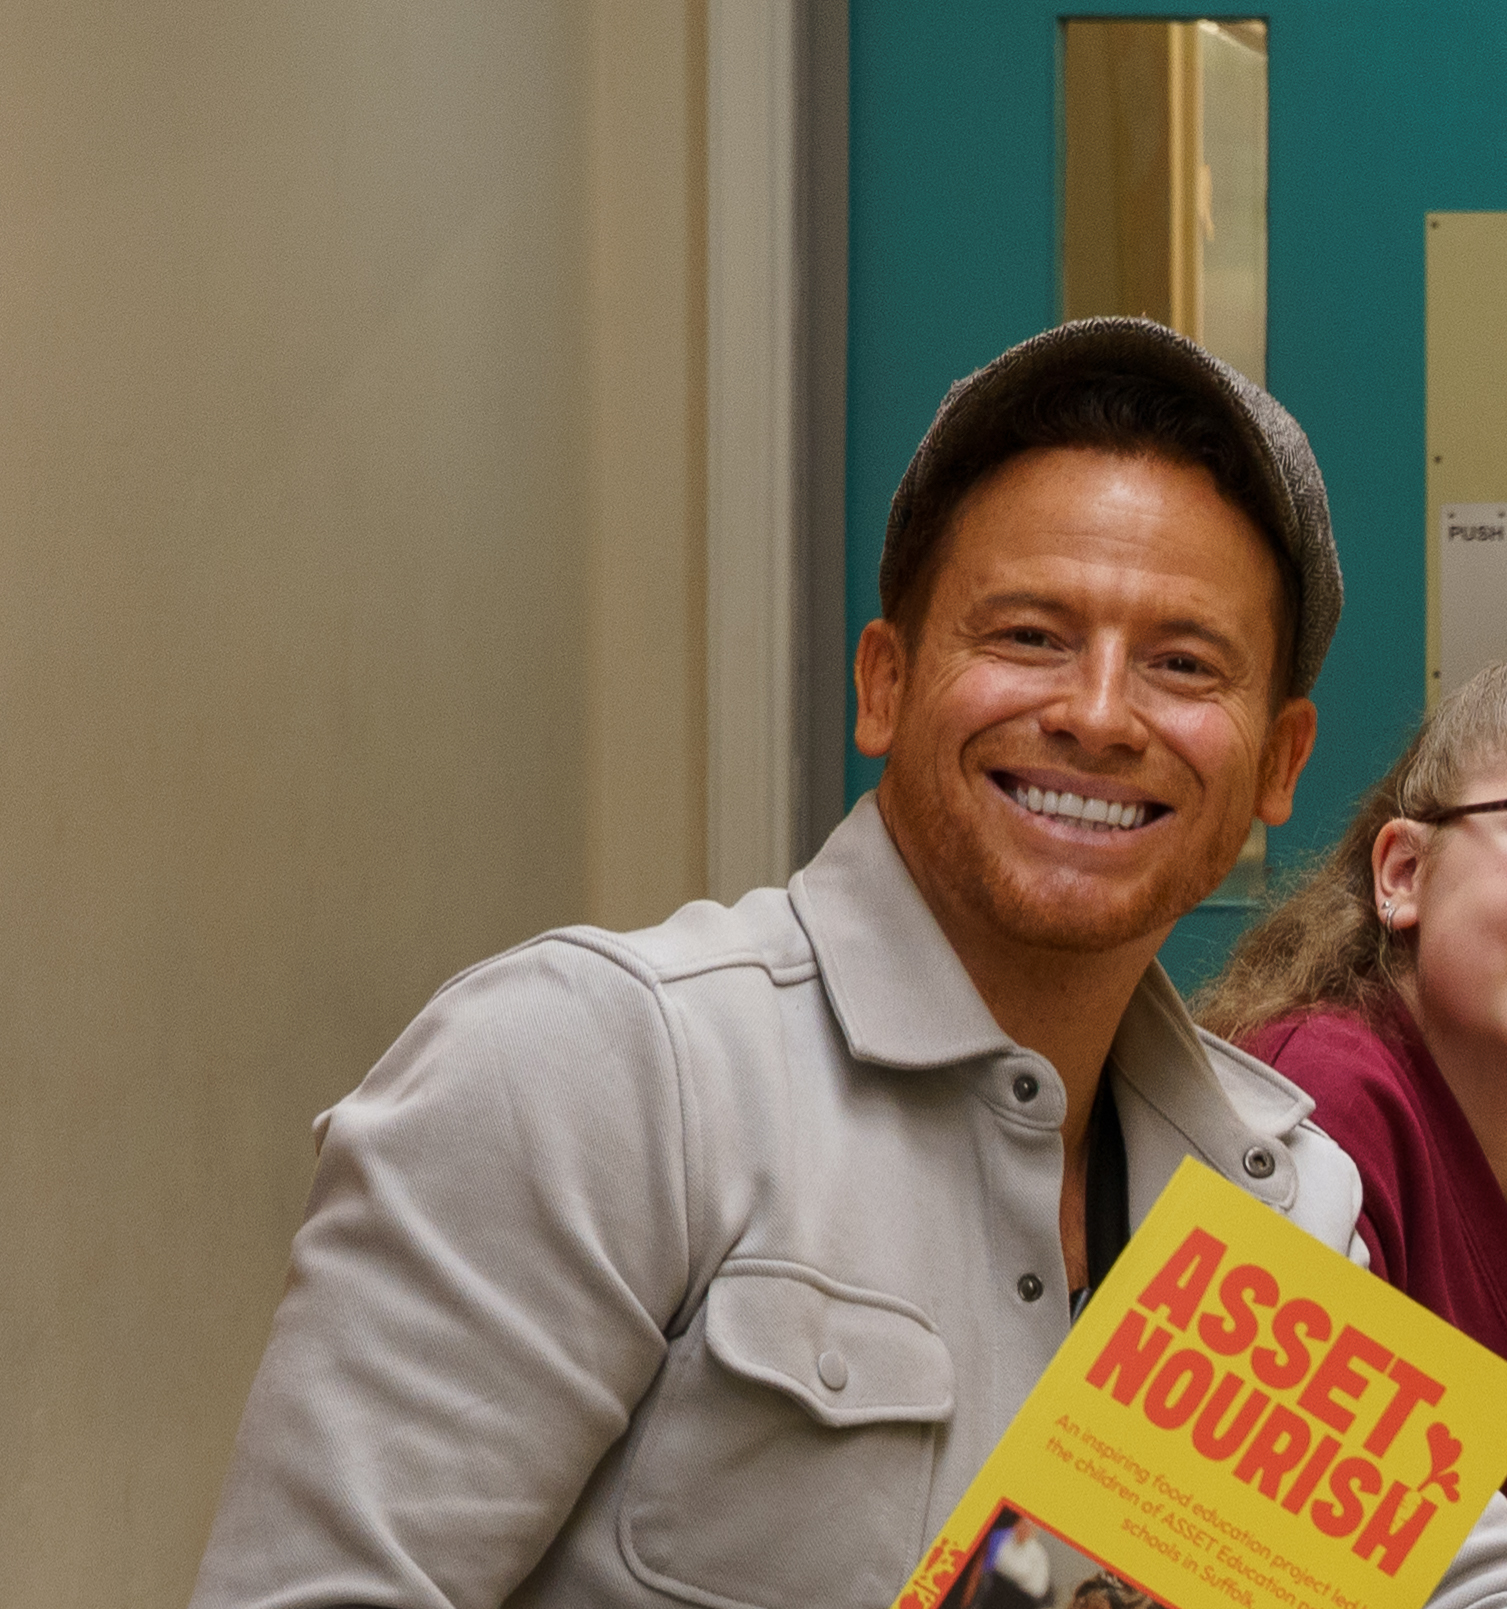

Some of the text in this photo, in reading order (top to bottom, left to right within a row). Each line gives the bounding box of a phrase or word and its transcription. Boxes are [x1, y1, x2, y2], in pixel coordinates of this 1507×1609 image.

[1448, 525, 1504, 541] PUSH
[1136, 1226, 1446, 1459] ASSET
[1047, 1436, 1073, 1462] the
[1074, 1458, 1140, 1505] children
[1141, 1501, 1165, 1518] of
[1161, 1512, 1218, 1553] ASSET
[1216, 1545, 1296, 1606] Education
[1055, 1414, 1081, 1436] An
[1082, 1427, 1149, 1485] inspiring
[1152, 1474, 1194, 1507] food
[1192, 1503, 1271, 1560] education
[1270, 1555, 1331, 1596] project
[1085, 1308, 1438, 1578] NOURISH
[1122, 1518, 1181, 1563] schools
[1181, 1553, 1199, 1573] in
